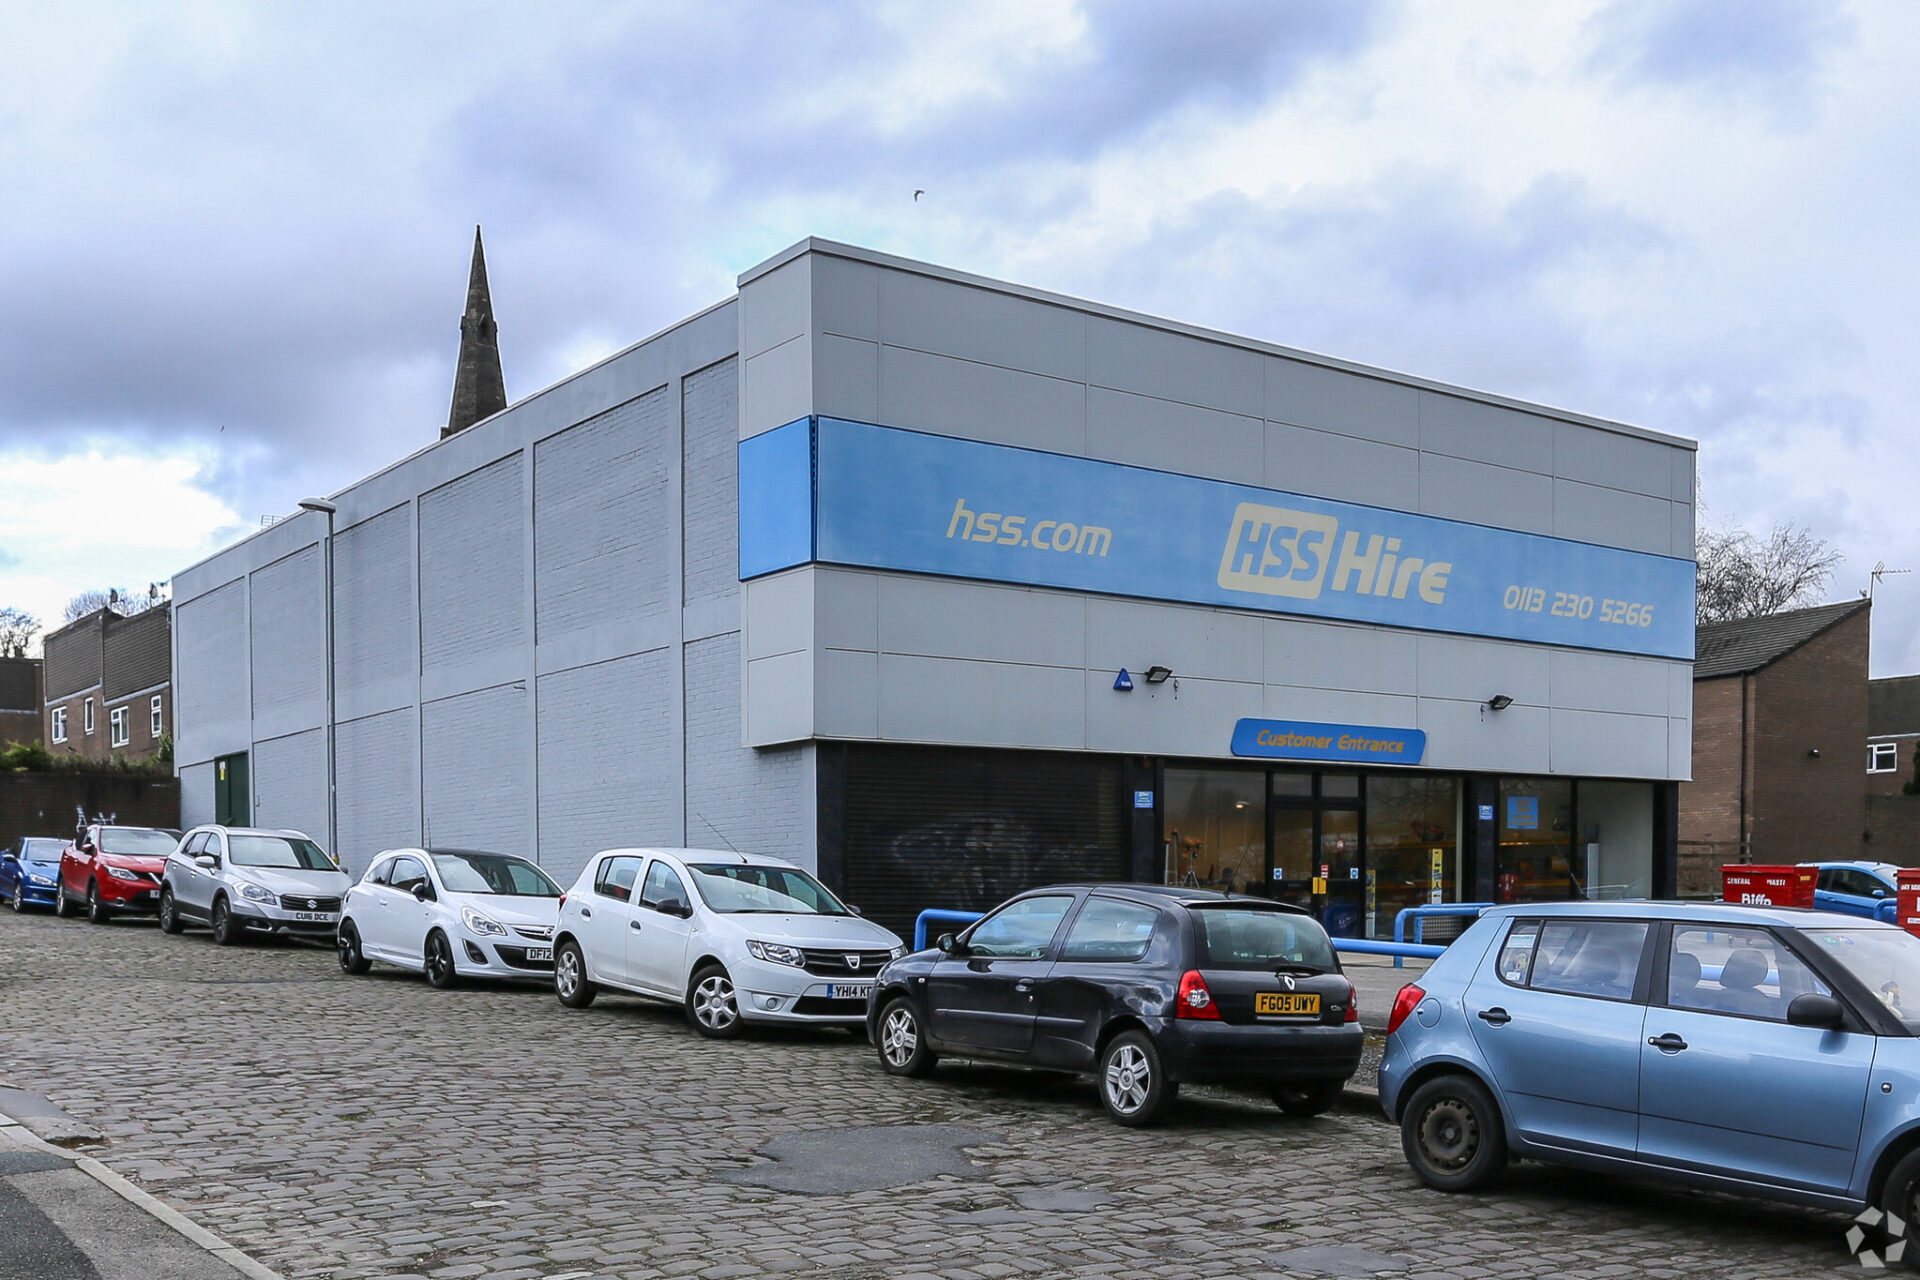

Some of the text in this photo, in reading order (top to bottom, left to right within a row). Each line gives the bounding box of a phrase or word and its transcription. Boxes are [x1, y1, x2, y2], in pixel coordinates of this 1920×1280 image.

[946, 498, 1112, 557] hss.com
[1229, 518, 1453, 605] HSS Hire
[1503, 585, 1655, 628] 0113 230 5266
[1257, 730, 1405, 753] Customer Entrance
[836, 986, 858, 998] YH14
[1260, 996, 1316, 1011] FG05 UWY
